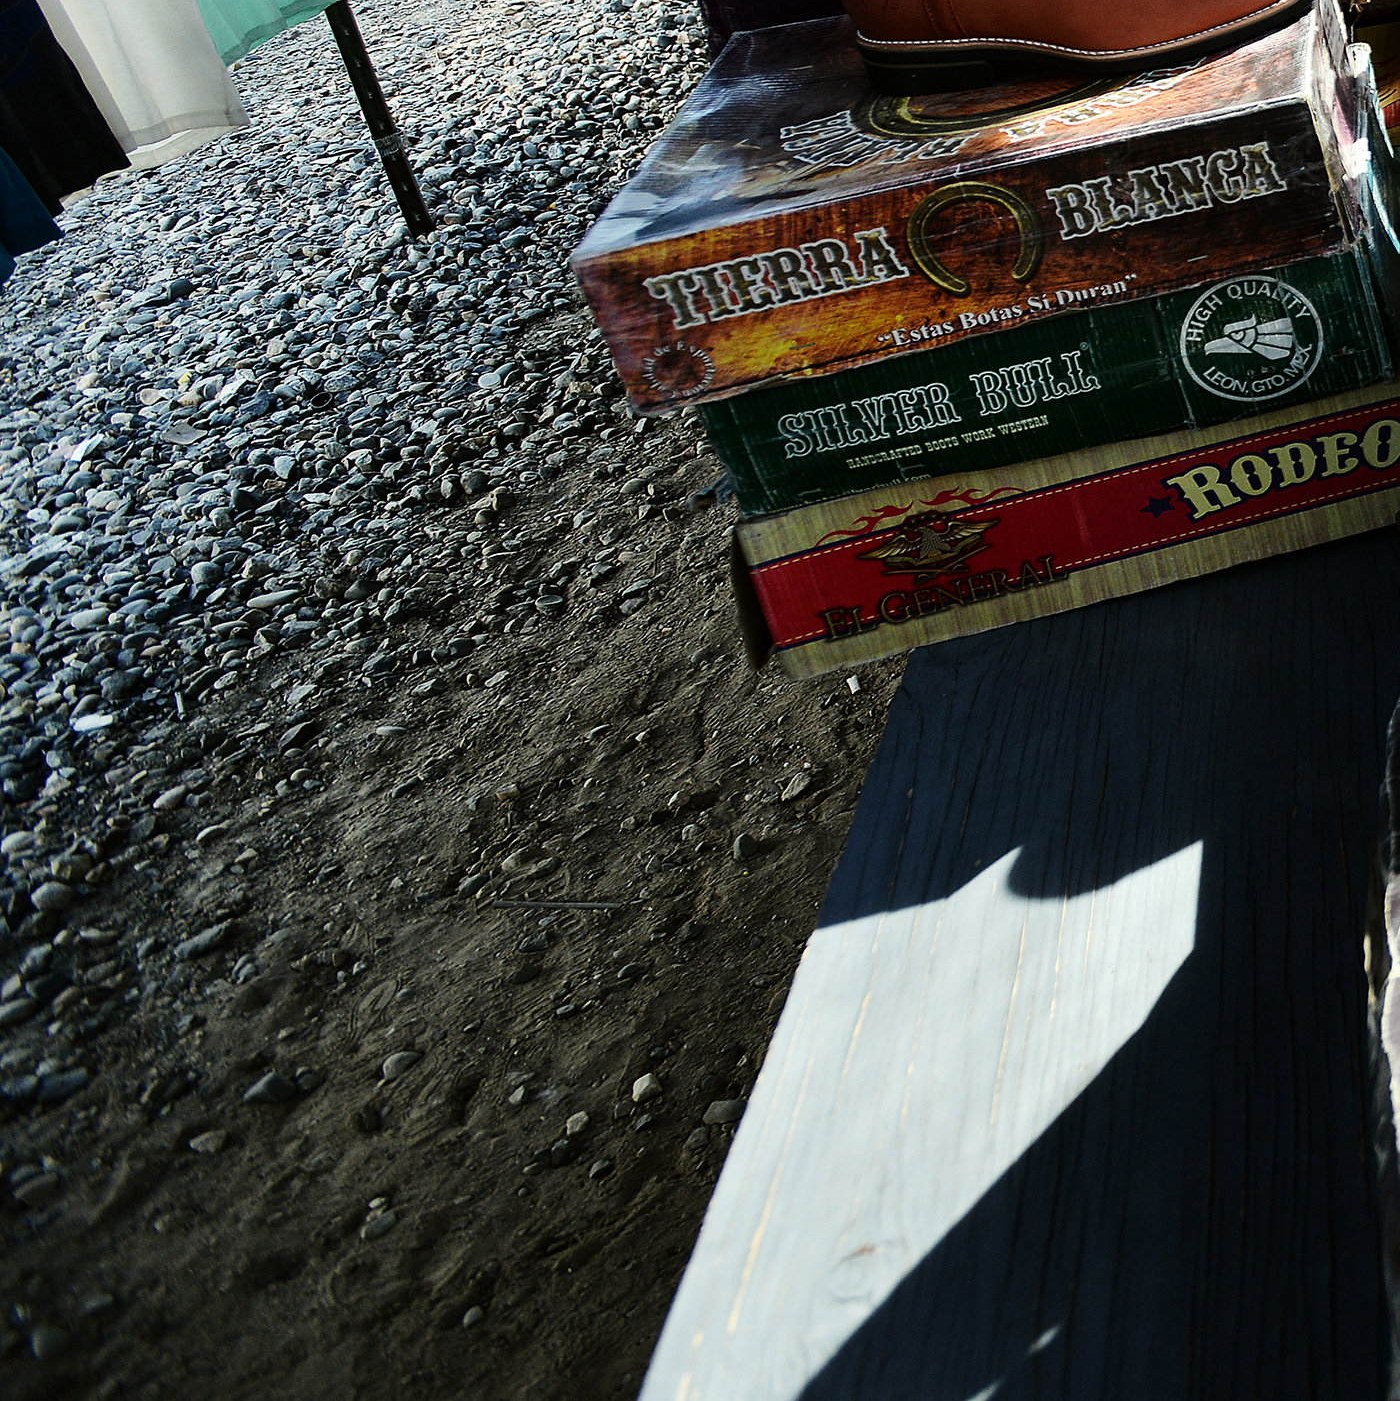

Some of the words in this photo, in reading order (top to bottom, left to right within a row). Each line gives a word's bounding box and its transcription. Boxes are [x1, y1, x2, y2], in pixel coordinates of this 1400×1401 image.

[642, 226, 910, 330] TIERRA
[1045, 141, 1288, 240] BLANCA
[961, 303, 1023, 330] Botas
[1186, 294, 1223, 342] HIGH
[1226, 281, 1311, 318] QUALITY
[777, 382, 962, 459] SILVER
[969, 350, 1102, 416] BULL
[846, 444, 923, 469] HANDCRAFTED
[926, 436, 960, 453] BOOTS
[961, 427, 996, 445] WORK
[997, 414, 1050, 437] WESTERN
[823, 608, 877, 640] EL
[879, 555, 1070, 625] GENERAL
